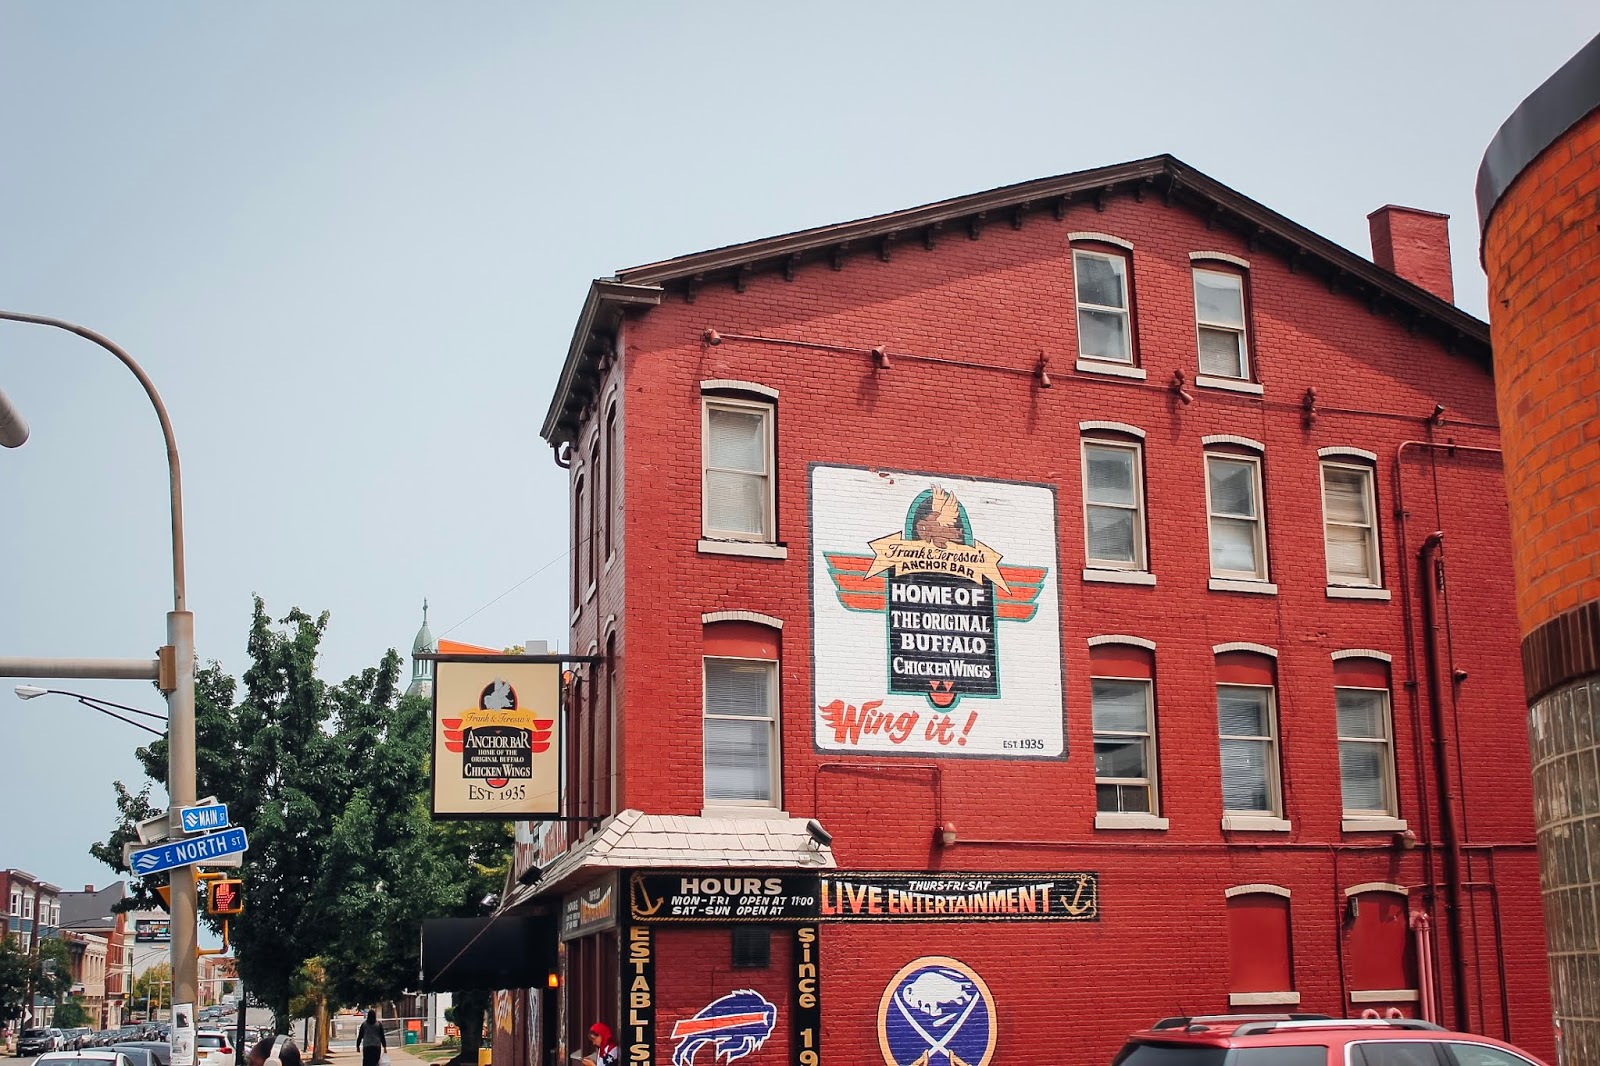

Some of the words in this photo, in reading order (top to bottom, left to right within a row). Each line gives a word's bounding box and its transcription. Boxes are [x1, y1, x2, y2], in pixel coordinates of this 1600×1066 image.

[885, 543, 926, 558] Frank
[927, 548, 934, 560] &
[934, 549, 985, 564] Teressa's
[901, 560, 948, 574] ANCHOR
[950, 562, 975, 578] BAR
[892, 583, 952, 604] HOME
[953, 588, 985, 607] OF
[892, 611, 920, 629] THE
[923, 613, 990, 633] ORIGINAL
[901, 634, 987, 655] BUFFALO
[466, 713, 490, 723] Frank
[818, 699, 920, 745] Wing
[924, 710, 978, 747] it!
[465, 730, 508, 748] ANCHOR
[510, 731, 531, 748] BAR
[1019, 739, 1044, 750] 1935
[469, 785, 495, 800] EST.
[500, 785, 526, 800] 1935
[198, 809, 217, 826] MAIN
[220, 812, 225, 821] ST
[165, 851, 172, 862] E
[176, 836, 227, 861] NORTH
[231, 836, 241, 847] ST
[681, 878, 783, 895] HOURS
[908, 880, 992, 891] THURS-FRI-SAT
[671, 896, 730, 906] MON-FRI
[739, 896, 769, 906] OPEN
[772, 896, 787, 906] AT
[821, 879, 882, 915] LIVE
[888, 882, 1055, 914] ENTERTAINMENT
[671, 905, 731, 915] SAT-SUN
[736, 905, 767, 915] OPEN
[769, 906, 784, 915] AT
